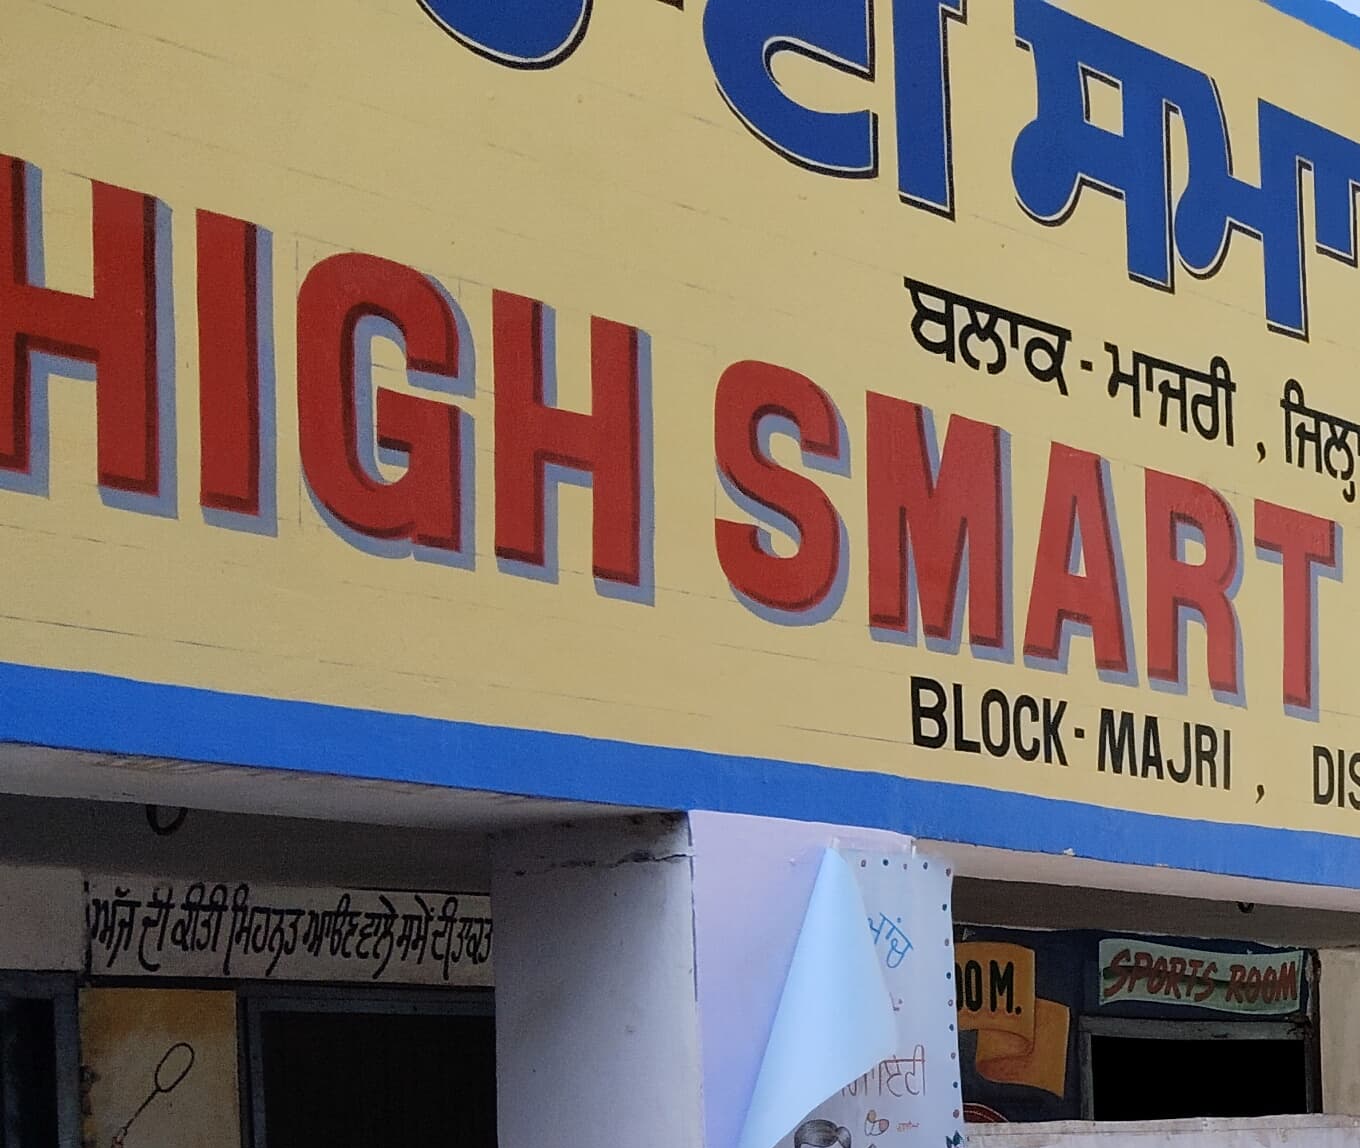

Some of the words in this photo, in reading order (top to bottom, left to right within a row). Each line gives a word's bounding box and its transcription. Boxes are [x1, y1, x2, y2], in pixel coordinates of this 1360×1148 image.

[0, 154, 655, 607] HIGH
[713, 360, 1343, 722] SMART
[1103, 948, 1219, 1001] SPORTS
[1225, 961, 1299, 1004] ROOM
